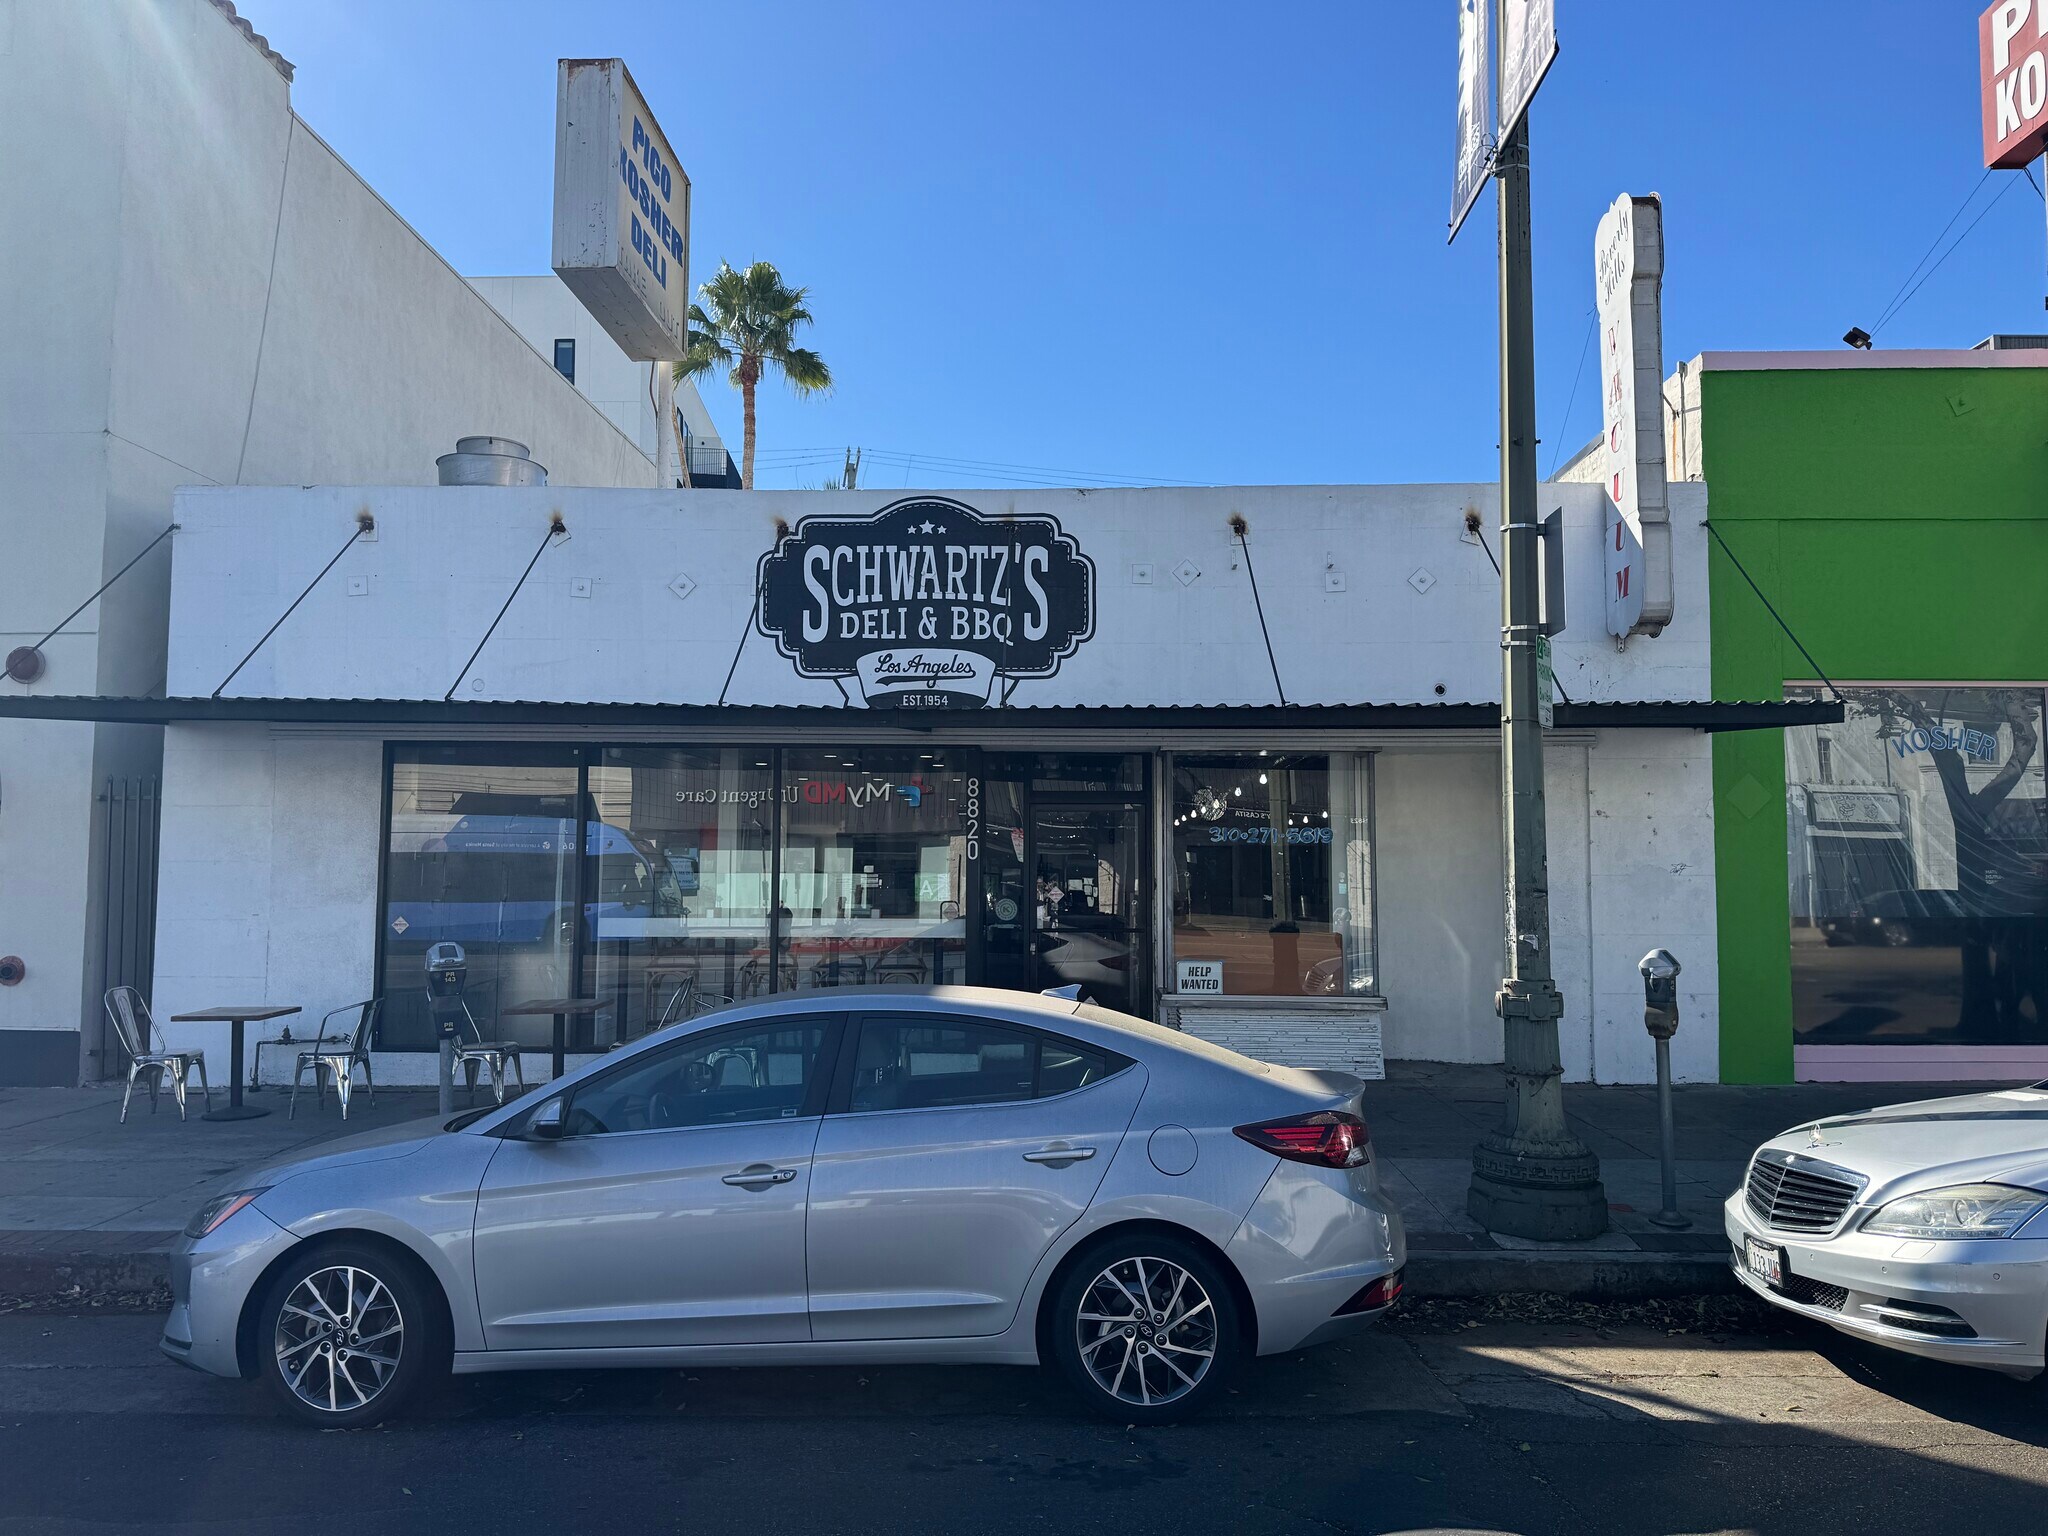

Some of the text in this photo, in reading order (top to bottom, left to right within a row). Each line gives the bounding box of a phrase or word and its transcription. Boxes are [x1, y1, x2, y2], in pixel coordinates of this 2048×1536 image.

[632, 115, 671, 204] PICO
[631, 211, 667, 290] DELI
[1600, 209, 1630, 284] Beverly
[1605, 256, 1625, 306] Hills
[802, 542, 1049, 644] SCHWARTZ'S
[839, 605, 1014, 647] DELI & BBQ
[874, 653, 975, 688] Los Angeles
[1891, 726, 1997, 762] KOSHER
[967, 777, 979, 861] 8820
[919, 879, 934, 897] A
[1181, 979, 1219, 990] WANTED
[1188, 966, 1211, 977] HELP
